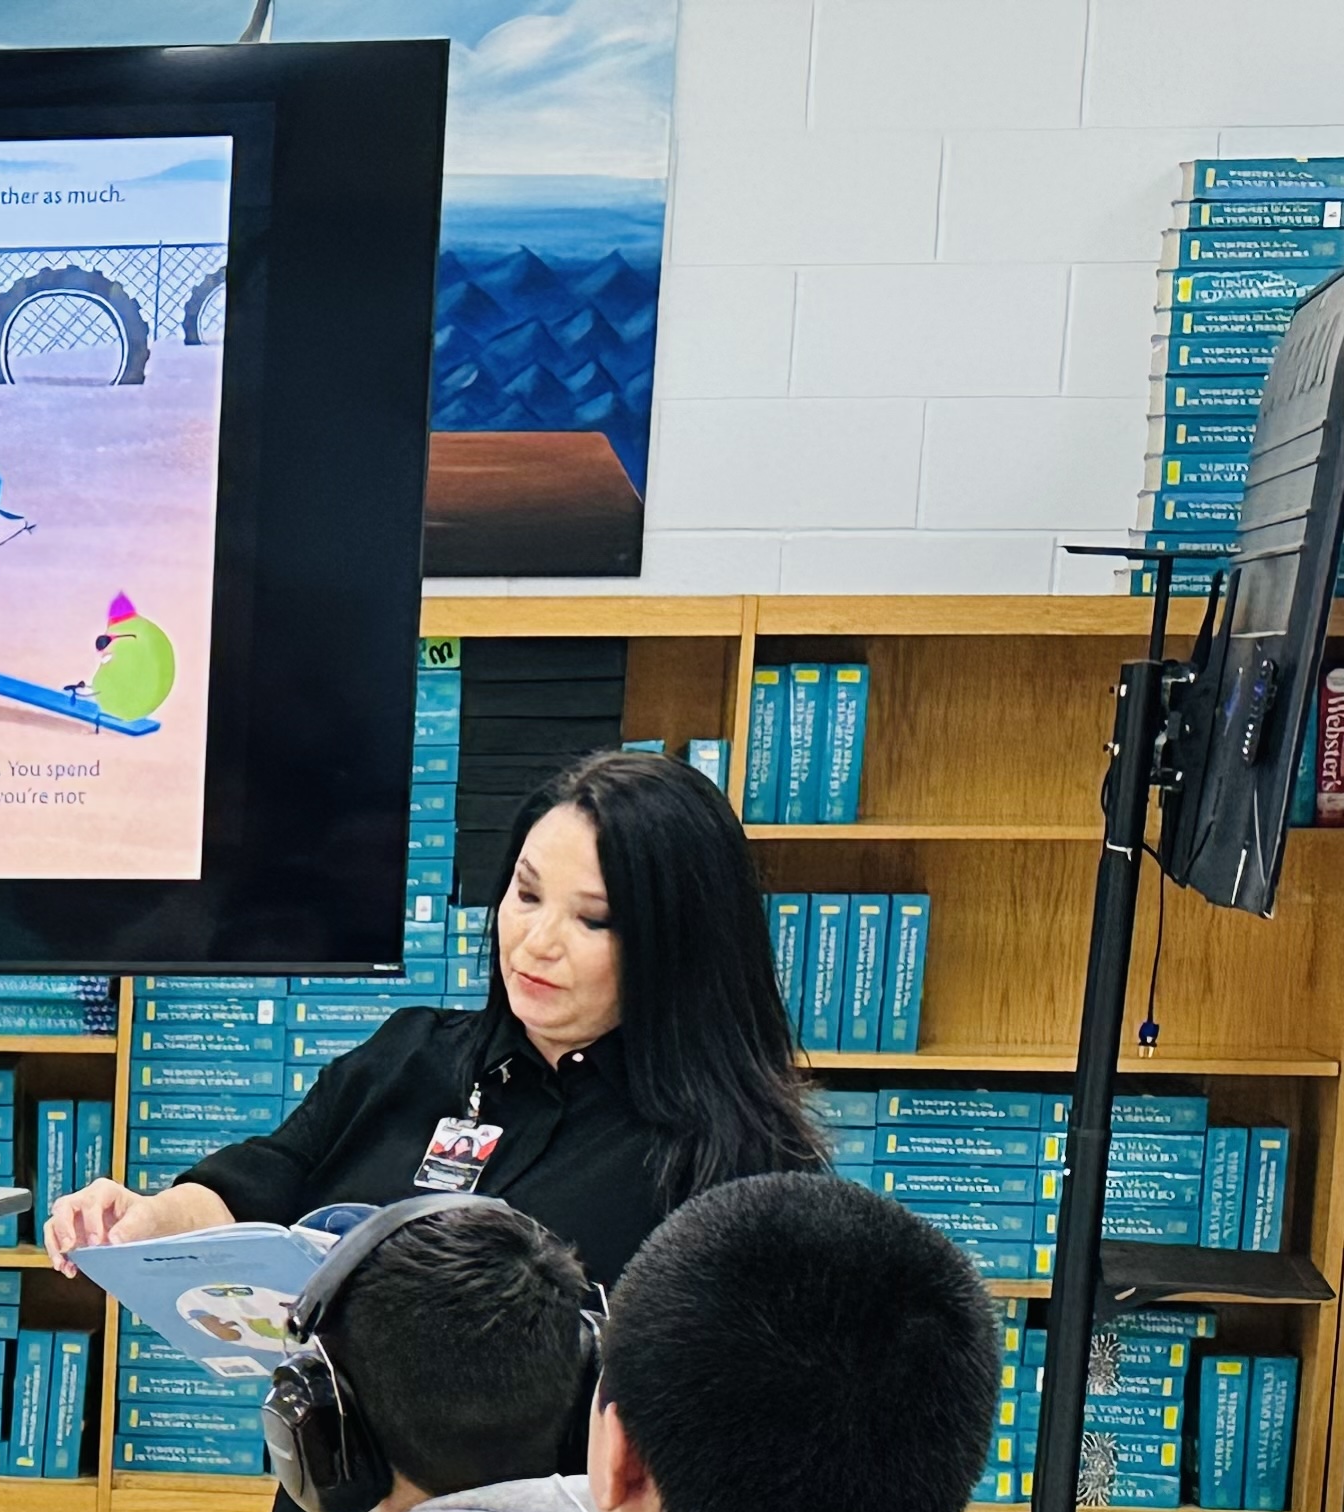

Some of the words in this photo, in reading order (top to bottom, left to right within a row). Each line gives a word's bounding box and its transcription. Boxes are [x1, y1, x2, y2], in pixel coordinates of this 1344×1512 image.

[43, 190, 62, 205] as
[67, 184, 126, 205] much.
[8, 760, 41, 778] You
[46, 760, 101, 781] spend
[54, 791, 87, 805] not
